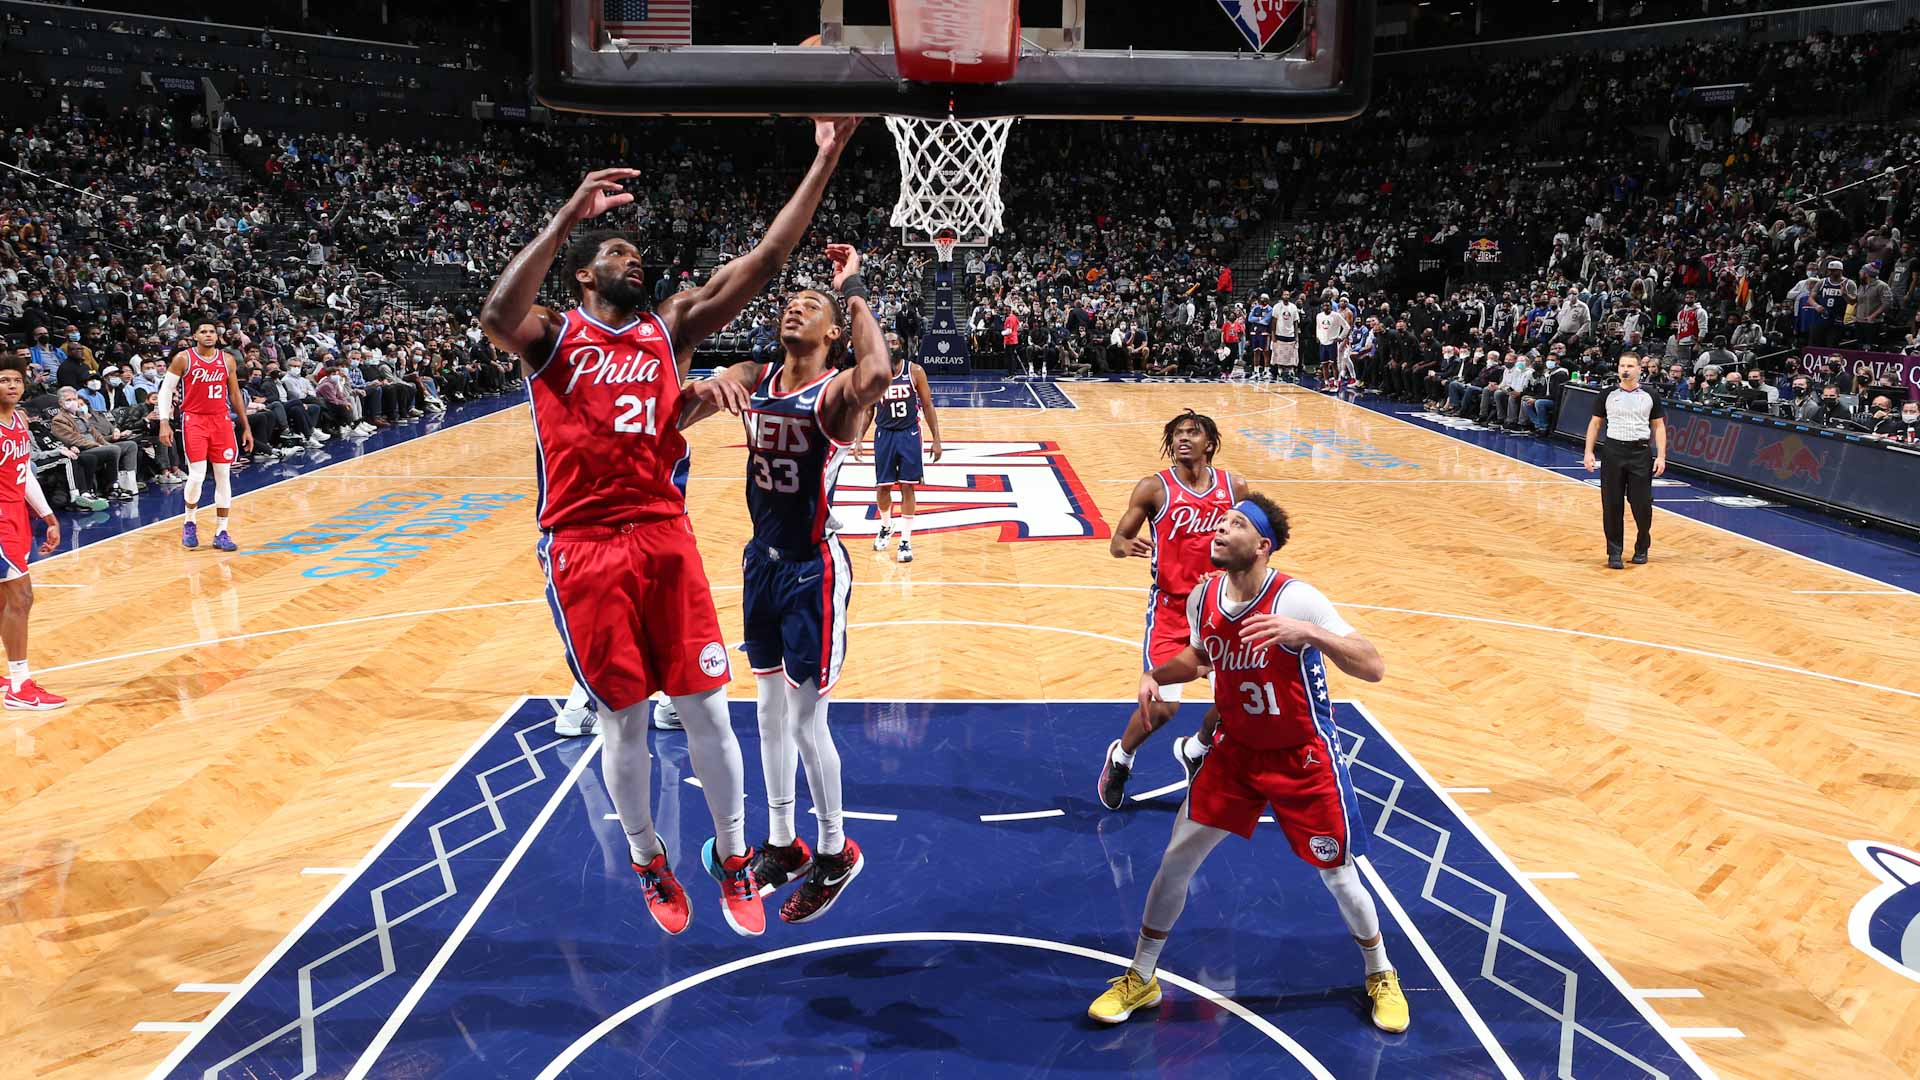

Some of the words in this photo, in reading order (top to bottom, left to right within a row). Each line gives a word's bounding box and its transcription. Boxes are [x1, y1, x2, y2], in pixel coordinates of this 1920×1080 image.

[191, 367, 225, 385] Phila
[565, 345, 661, 395] Phila
[923, 356, 965, 365] BARCLAYS
[207, 385, 223, 400] 12
[889, 401, 908, 418] 13
[614, 394, 656, 436] 21
[743, 411, 812, 453] NETS
[1655, 411, 1694, 453] ed
[1691, 415, 1742, 467] Bull
[753, 453, 800, 493] 33
[239, 490, 443, 556] CENTER
[301, 492, 528, 580] BARCLAYS
[1239, 681, 1281, 716] 31
